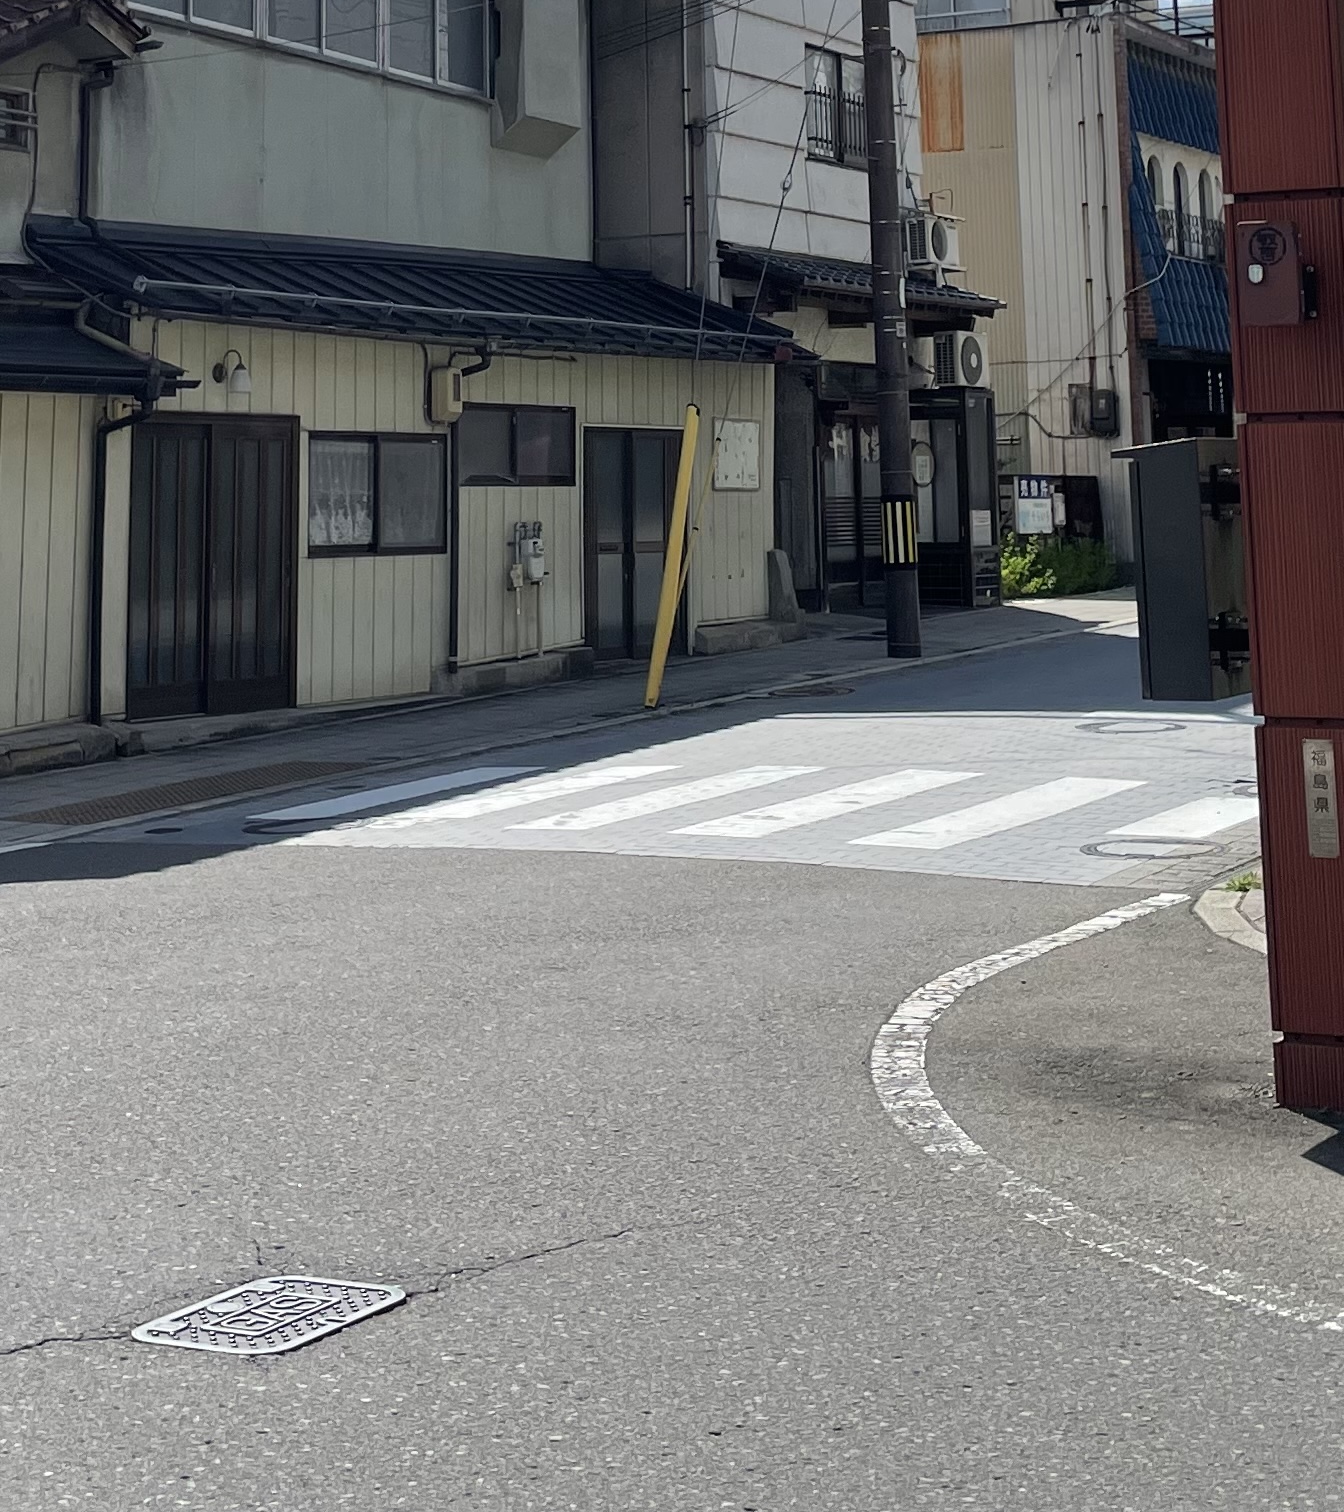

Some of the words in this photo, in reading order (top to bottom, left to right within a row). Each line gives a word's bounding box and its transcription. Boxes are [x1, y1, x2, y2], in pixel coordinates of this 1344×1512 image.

[1311, 749, 1330, 814] 福島県
[220, 1294, 325, 1331] GAS
